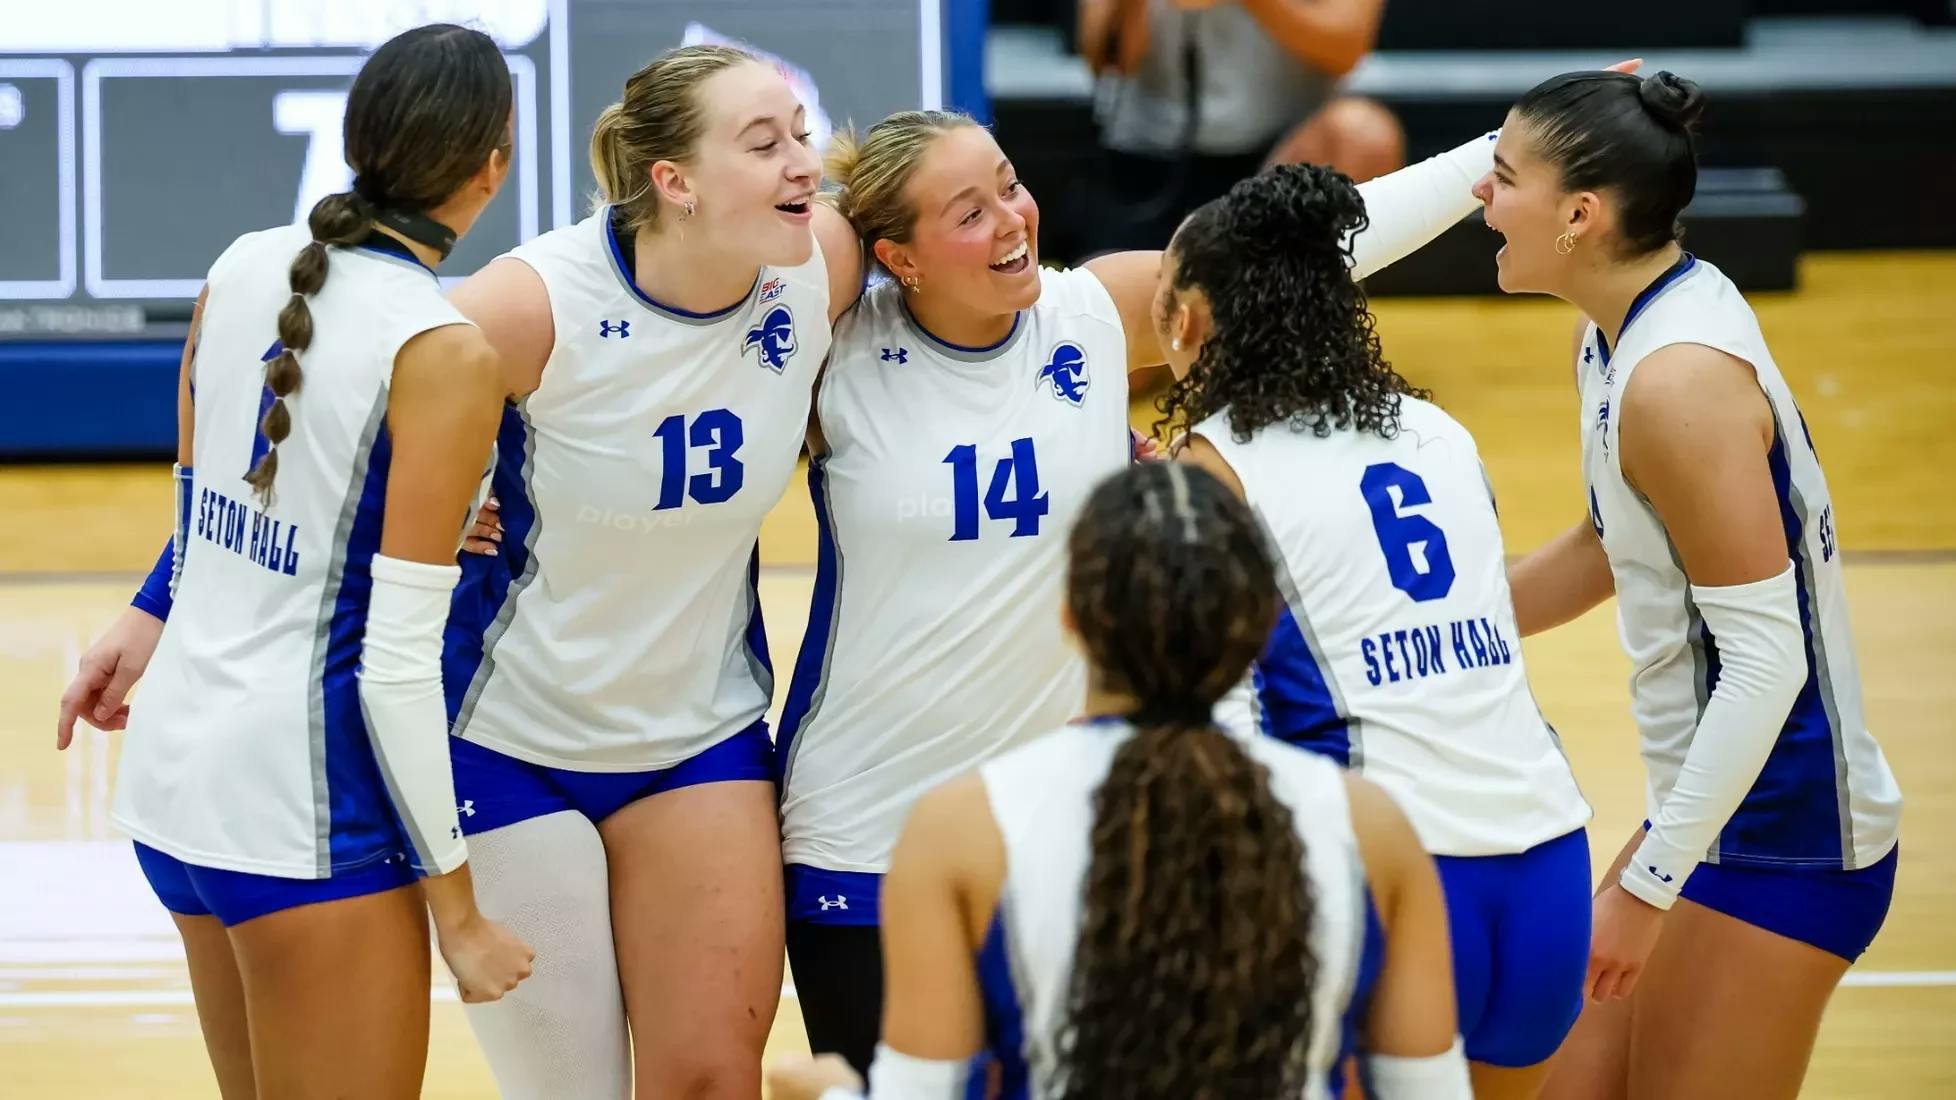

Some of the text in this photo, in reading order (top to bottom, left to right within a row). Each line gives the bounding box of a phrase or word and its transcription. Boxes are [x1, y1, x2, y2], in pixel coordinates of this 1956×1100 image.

[761, 277, 780, 293] BIG
[651, 408, 744, 511] 13
[942, 436, 1049, 541] 14
[197, 486, 299, 577] SETON HALL
[1359, 461, 1456, 603] 6
[1360, 617, 1511, 687] SETON HALL
